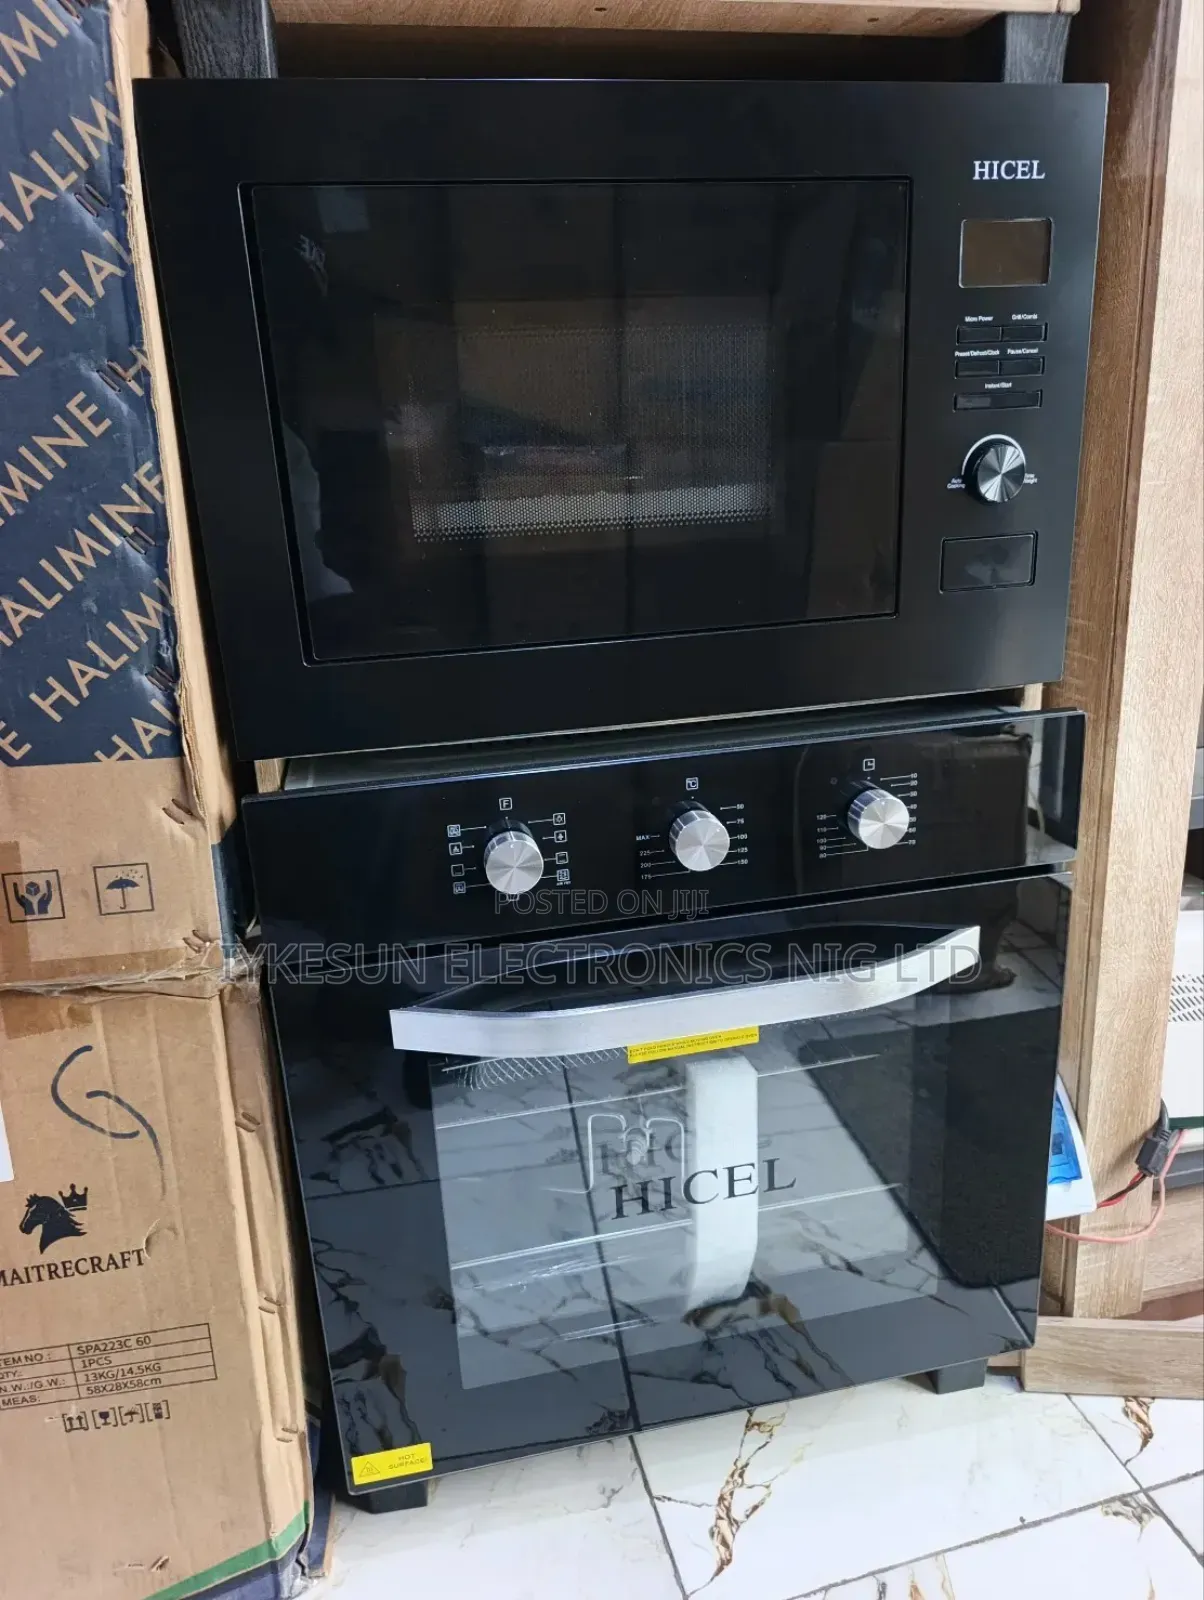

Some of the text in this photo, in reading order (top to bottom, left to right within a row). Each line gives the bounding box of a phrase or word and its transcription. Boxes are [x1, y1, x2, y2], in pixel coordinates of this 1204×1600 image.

[972, 159, 1046, 181] HICEL
[0, 391, 112, 527] MINE
[610, 1157, 797, 1220] HICEL
[77, 1335, 151, 1356] SPA223C 60
[81, 1356, 113, 1369] 1PCS
[84, 1362, 162, 1383] 13KG/14.5KG
[86, 1377, 162, 1395] 58X28X58cm
[398, 1453, 415, 1461] HOT
